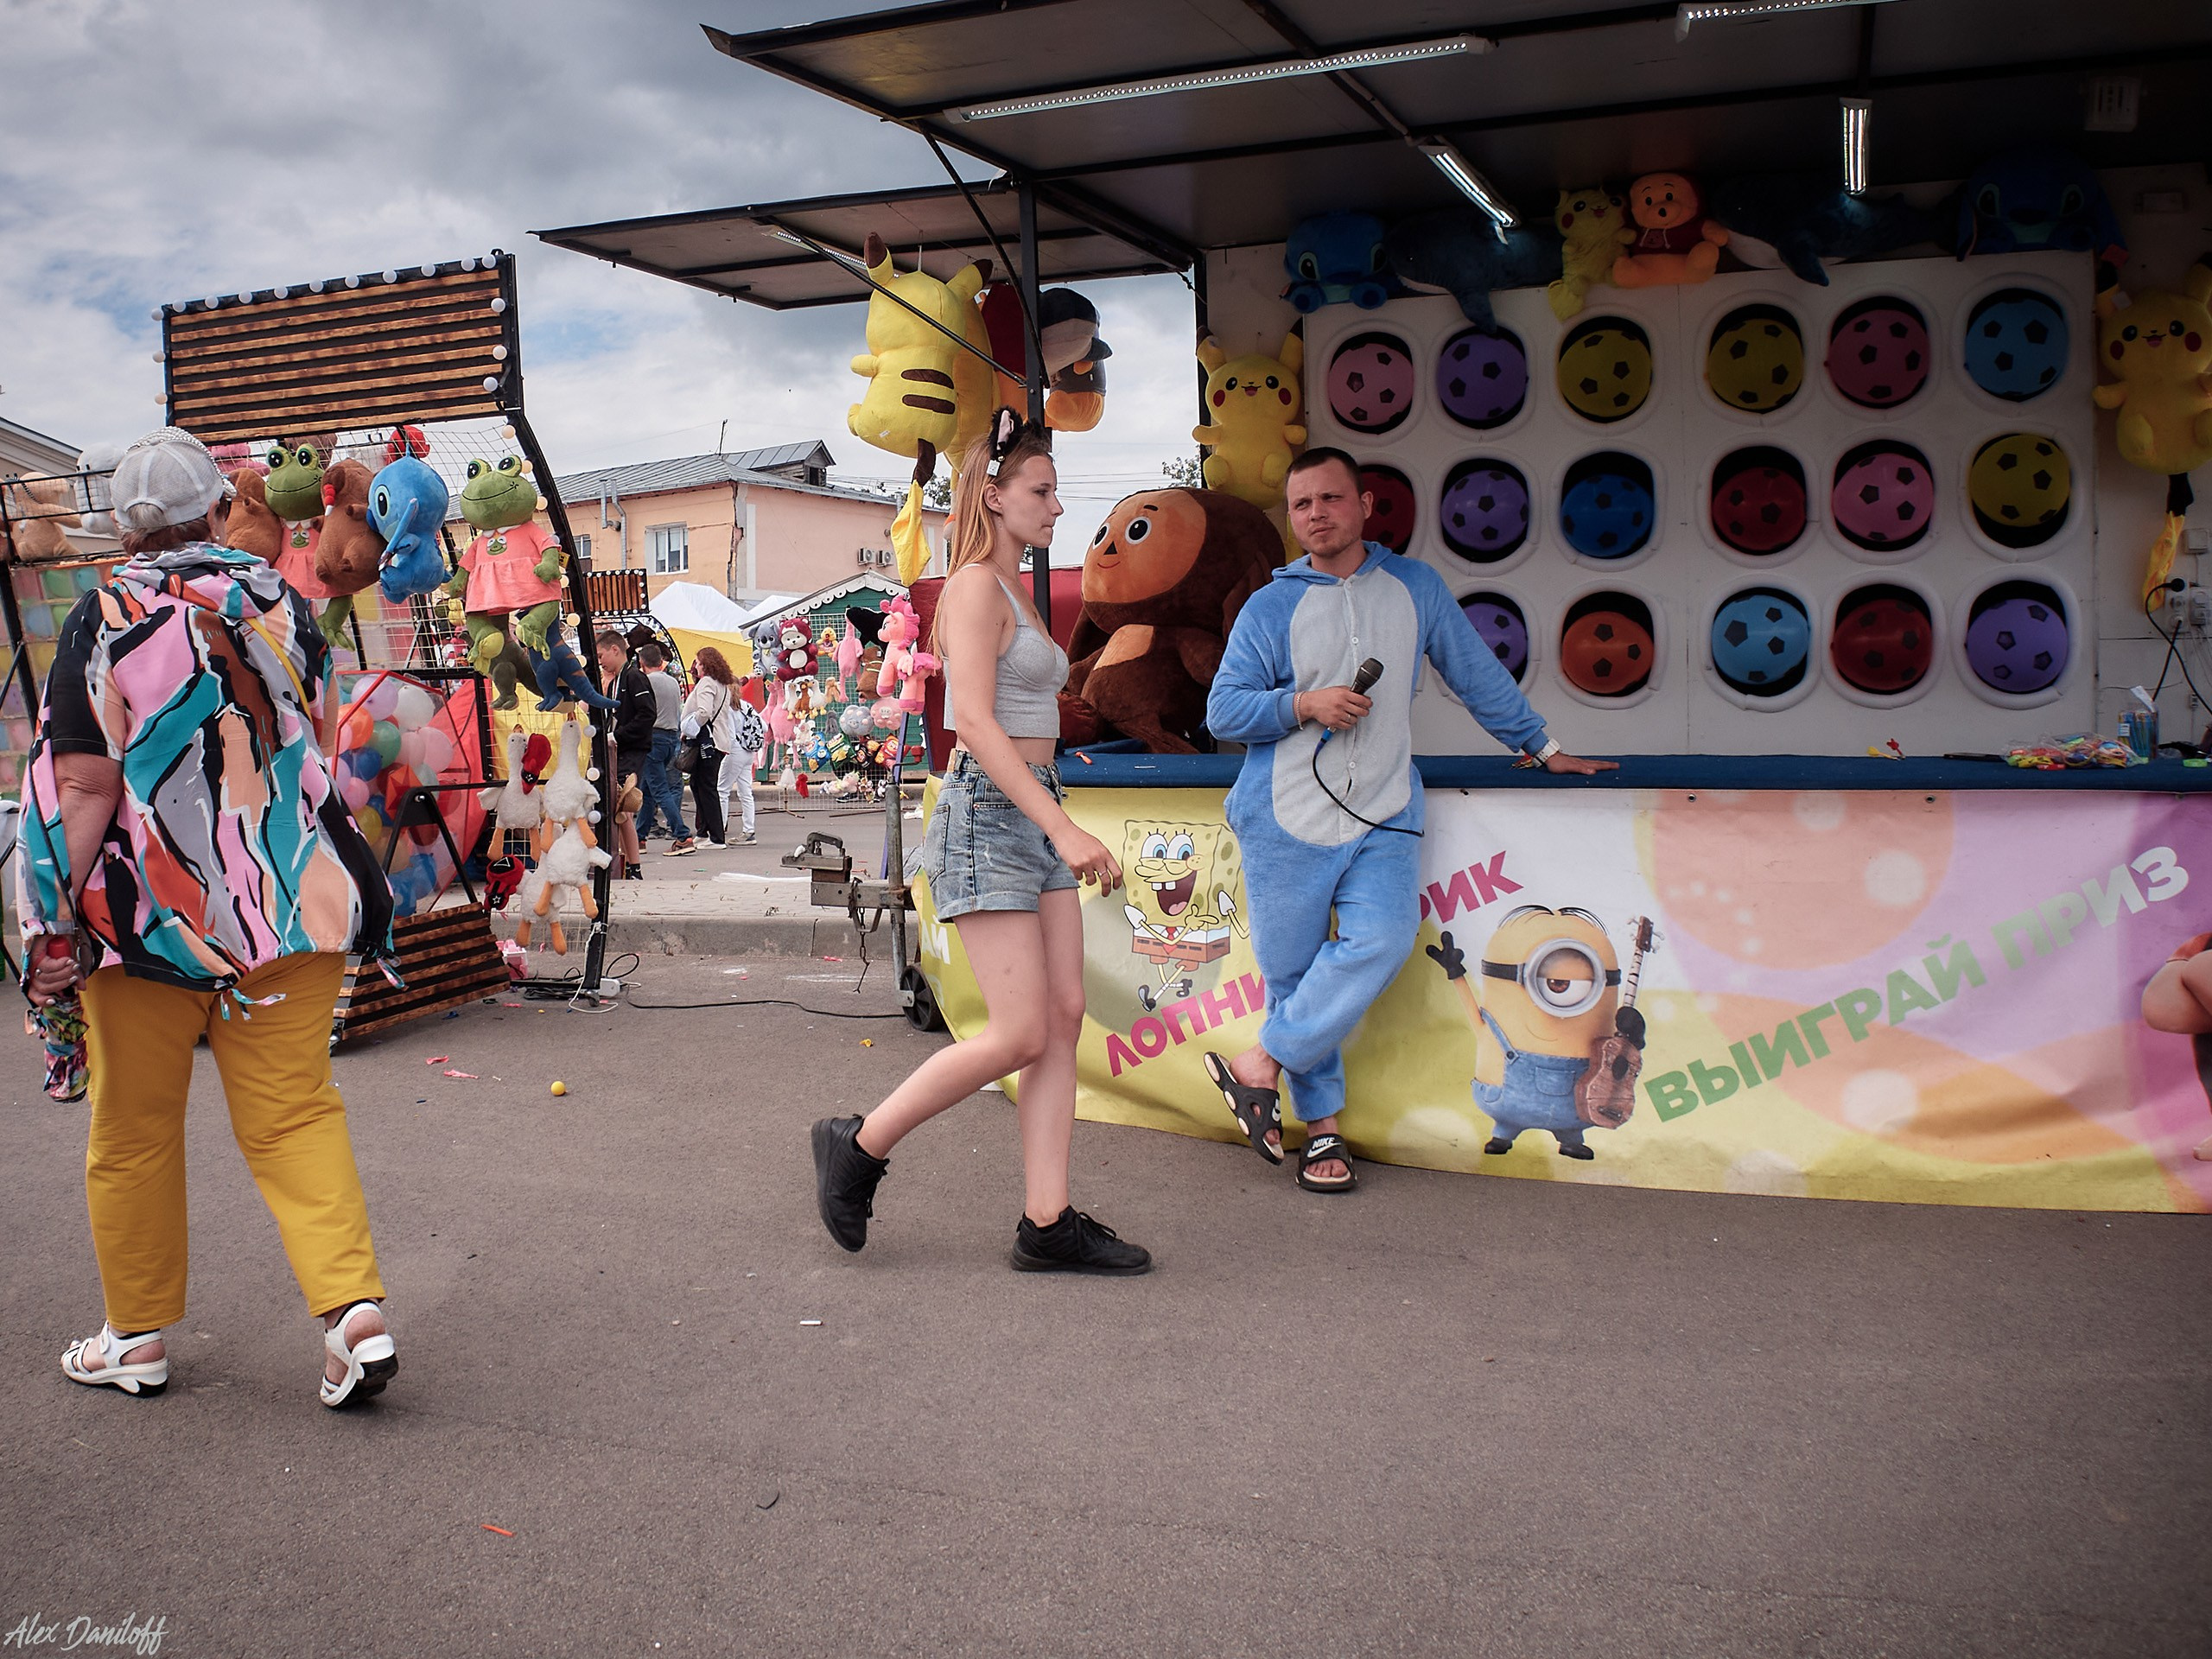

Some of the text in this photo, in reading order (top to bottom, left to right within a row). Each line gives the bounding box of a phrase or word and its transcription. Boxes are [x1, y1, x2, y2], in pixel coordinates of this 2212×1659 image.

[1644, 846, 2189, 1122] ВЫИГРАЙ ПРИЗ
[1312, 1137, 1336, 1149] NIKE
